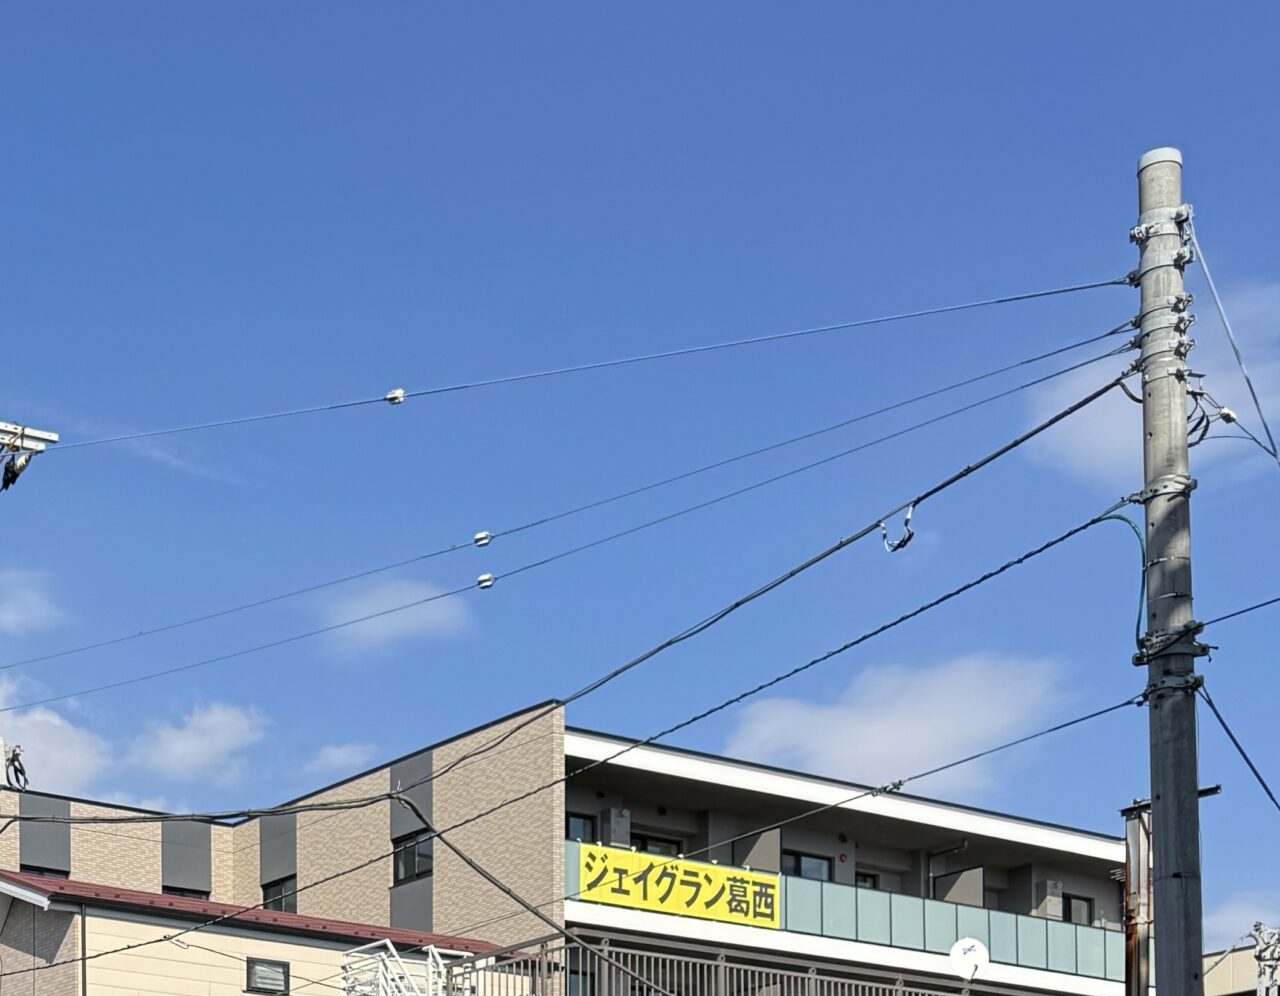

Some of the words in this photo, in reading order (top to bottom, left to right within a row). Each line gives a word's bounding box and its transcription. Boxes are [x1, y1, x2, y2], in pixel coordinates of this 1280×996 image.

[585, 851, 776, 922] ジェイグラン葛西
